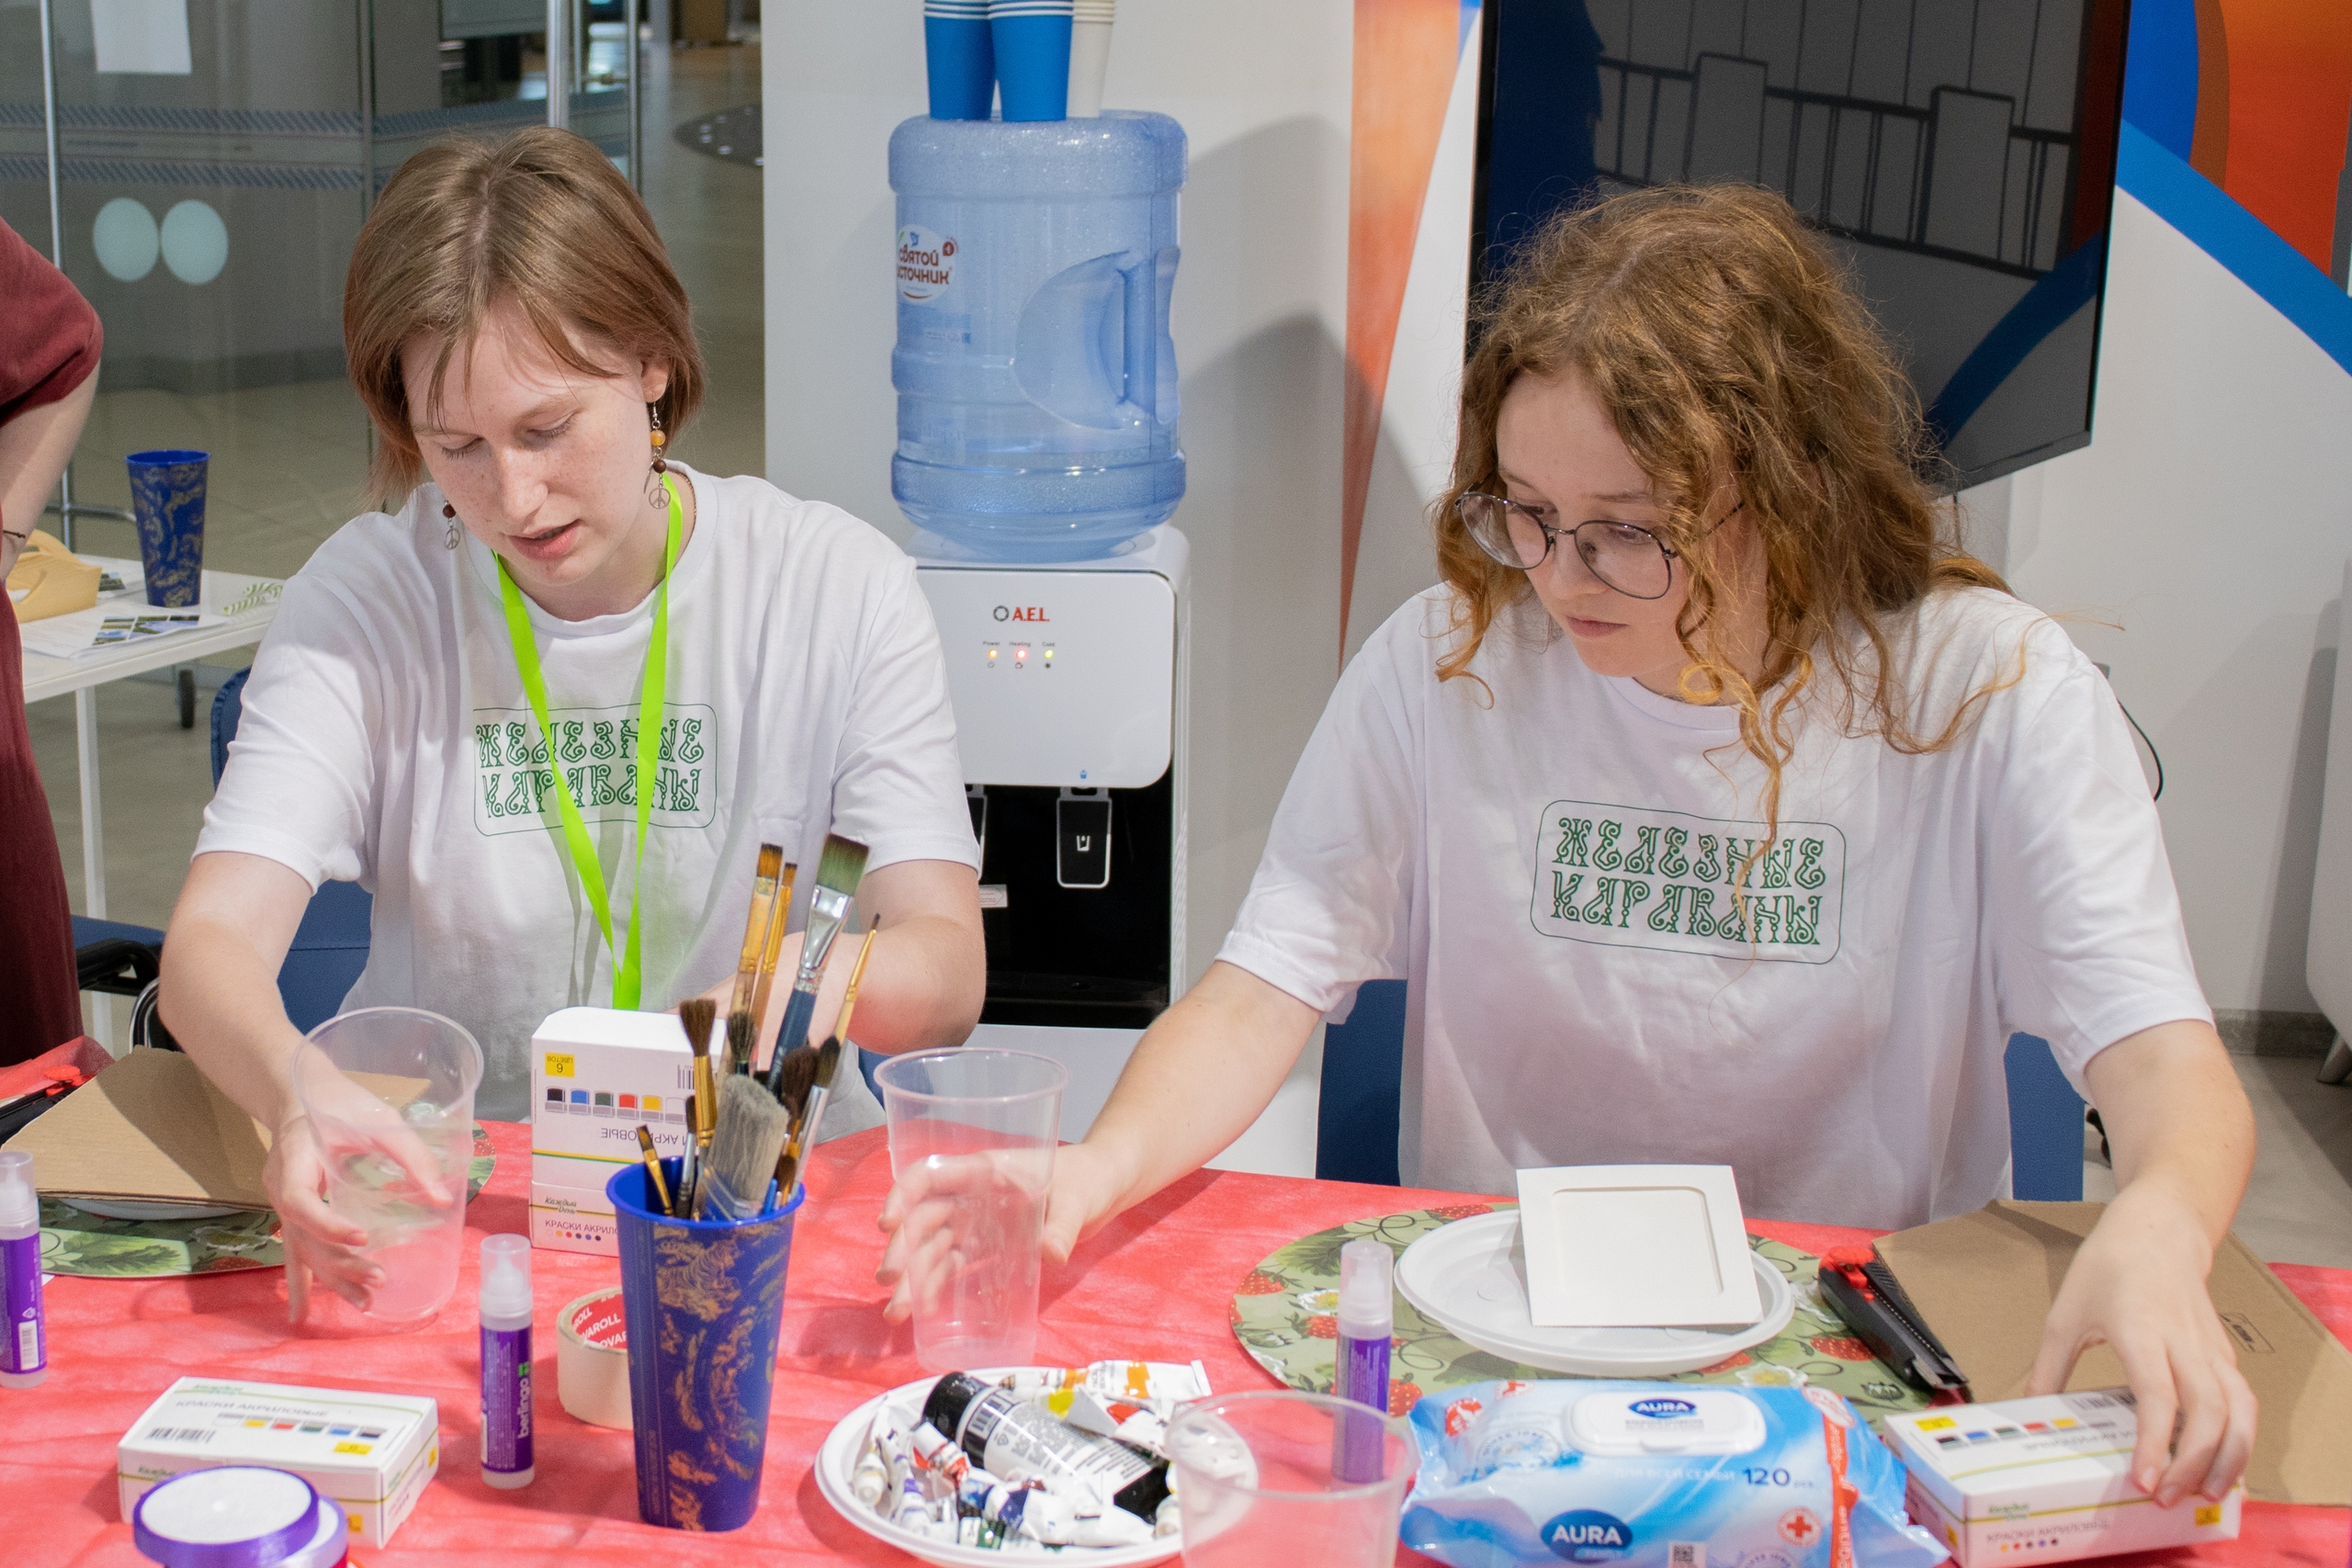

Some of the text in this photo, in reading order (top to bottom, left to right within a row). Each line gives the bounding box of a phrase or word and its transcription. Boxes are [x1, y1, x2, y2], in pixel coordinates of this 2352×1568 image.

[1552, 817, 1826, 890] ЖЕЛЕЗНЫЕ
[1550, 870, 1824, 945] КАРАВАНЫ
[546, 1055, 574, 1065] ЦВЕТОВ
[555, 1062, 564, 1074] 6
[600, 1127, 679, 1145] АКРОВЫЕ
[545, 1197, 577, 1207] Каждый
[545, 1219, 582, 1232] КРАСКИ
[517, 1378, 531, 1439] berlingo
[1635, 1401, 1690, 1413] AURA
[1743, 1467, 1791, 1486] 120
[1551, 1524, 1623, 1545] AURA
